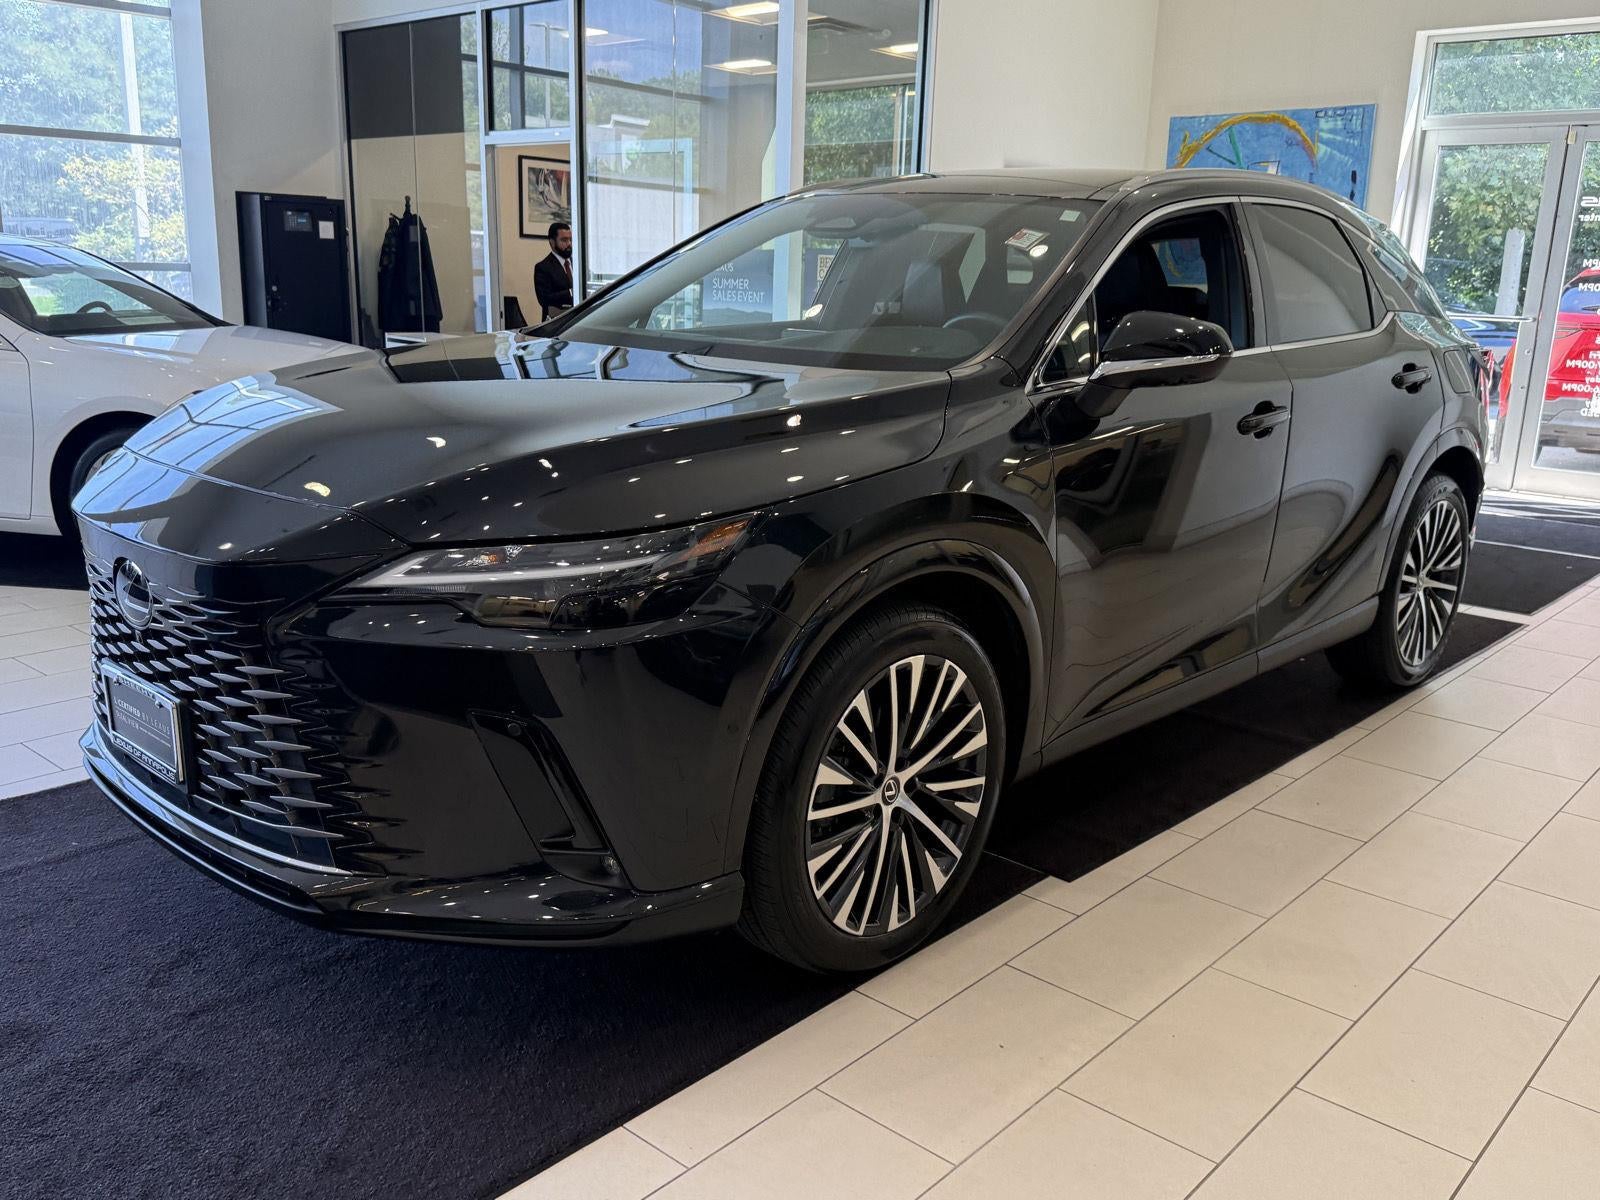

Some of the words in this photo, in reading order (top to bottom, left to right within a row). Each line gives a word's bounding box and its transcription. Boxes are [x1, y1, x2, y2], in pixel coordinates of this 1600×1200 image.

[712, 278, 750, 290] SUMMER
[712, 290, 737, 302] SALES
[738, 290, 765, 303] EVENT
[113, 736, 133, 753] LEXUS
